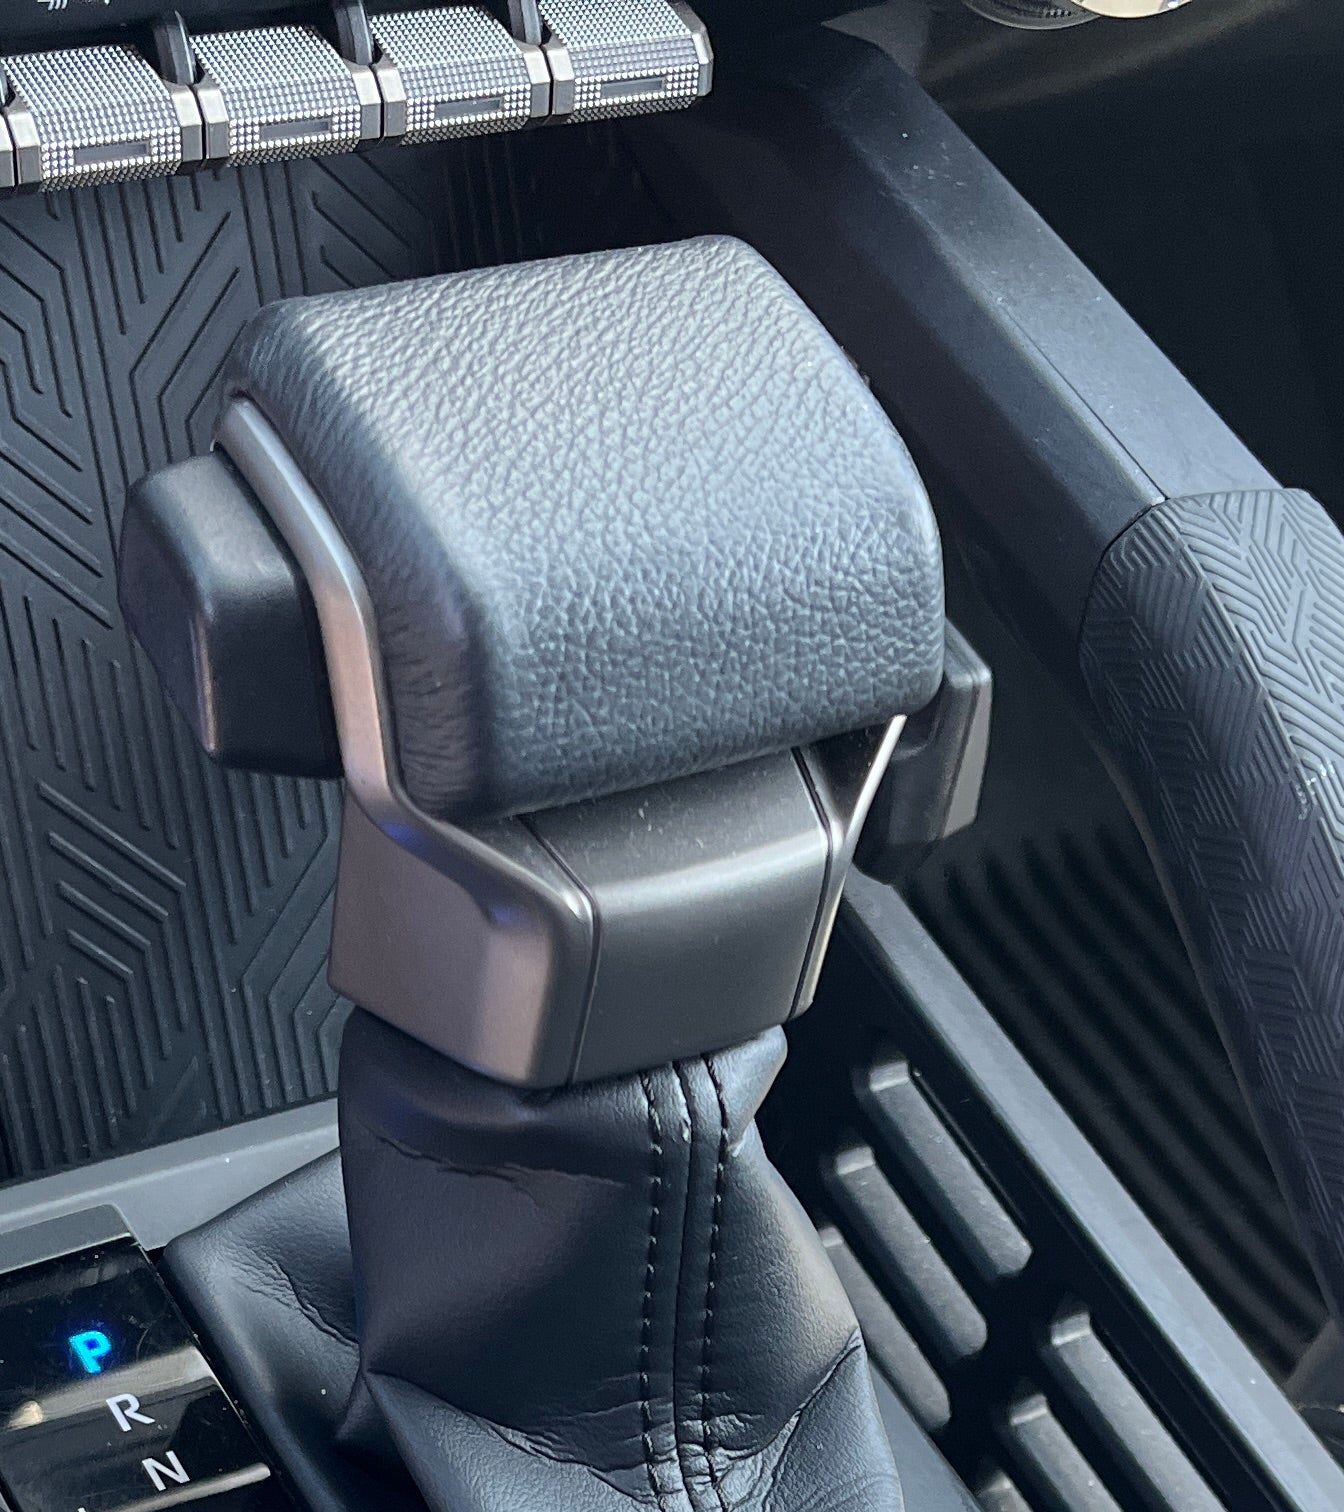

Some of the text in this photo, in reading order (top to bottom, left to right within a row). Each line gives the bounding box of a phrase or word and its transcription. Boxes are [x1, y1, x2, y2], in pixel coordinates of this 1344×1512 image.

[67, 1330, 112, 1374] P
[106, 1393, 155, 1432] R
[142, 1450, 190, 1491] N
